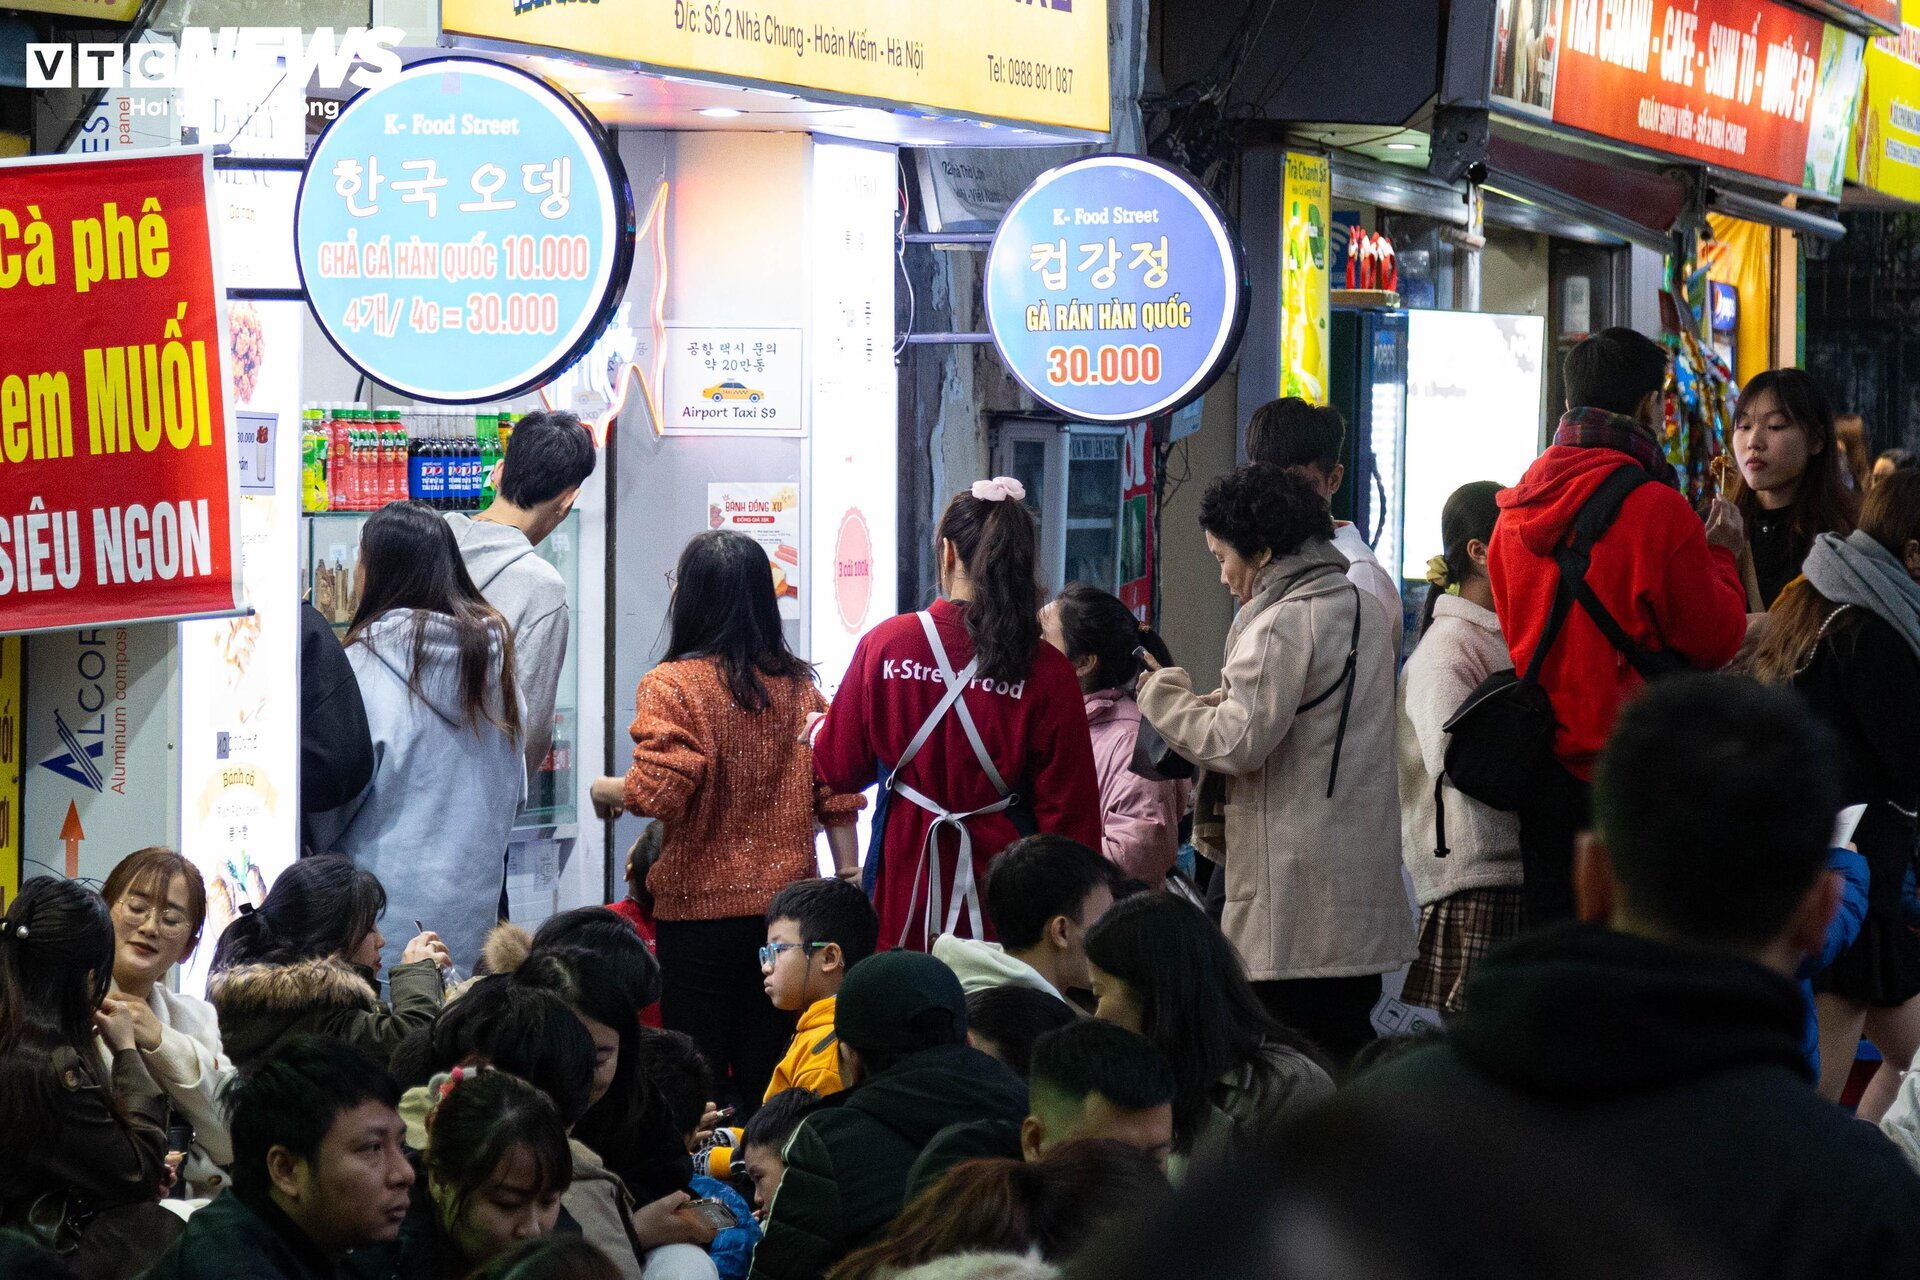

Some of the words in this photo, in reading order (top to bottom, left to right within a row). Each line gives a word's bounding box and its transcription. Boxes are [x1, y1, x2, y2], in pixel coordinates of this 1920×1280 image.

[704, 0, 721, 36] Số
[725, 10, 732, 37] 2
[736, 12, 760, 42] Nhà
[764, 14, 804, 57] Chung
[815, 24, 845, 57] Hoàn
[849, 27, 877, 62] Kiếm
[887, 37, 903, 67] Hà
[905, 41, 924, 77] Nội
[988, 54, 1005, 83] Tel:
[1009, 58, 1033, 88] 0988
[1035, 63, 1052, 91] 801
[1056, 67, 1073, 94] 087
[1660, 0, 1698, 88] CAFÉ
[1705, 21, 1740, 100] SINH
[1737, 11, 1761, 107] TỐ
[1793, 41, 1815, 124] ÉP
[117, 96, 133, 145] panel
[412, 113, 455, 135] Food
[461, 113, 520, 135] Street
[1074, 207, 1109, 225] Food
[1113, 206, 1159, 224] Street
[0, 204, 55, 289] Cà
[72, 196, 170, 293] phê
[318, 227, 360, 279] CHẢ
[364, 234, 391, 279] CÁ
[395, 236, 439, 279] HÀN
[442, 229, 498, 283] QUỐC
[503, 234, 590, 280] 10.000
[467, 293, 559, 336] 30.000
[1026, 299, 1051, 332] GÀ
[1055, 298, 1093, 331] RÁN
[1098, 298, 1137, 330] HÀN
[1141, 292, 1192, 332] QUỐC
[0, 370, 74, 464] em
[84, 301, 212, 456] MUỐI
[1047, 344, 1161, 386] 30.000
[682, 406, 728, 420] Airport
[732, 407, 757, 418] Taxi
[761, 407, 776, 419] $9
[725, 499, 746, 512] BÁNH
[748, 498, 770, 512] ĐỒNG
[771, 501, 783, 512] XU
[0, 496, 82, 596] SIÊU
[92, 498, 212, 586] NGON
[838, 562, 843, 577] 3
[111, 706, 127, 795] Aluminum
[223, 768, 244, 788] Bánh
